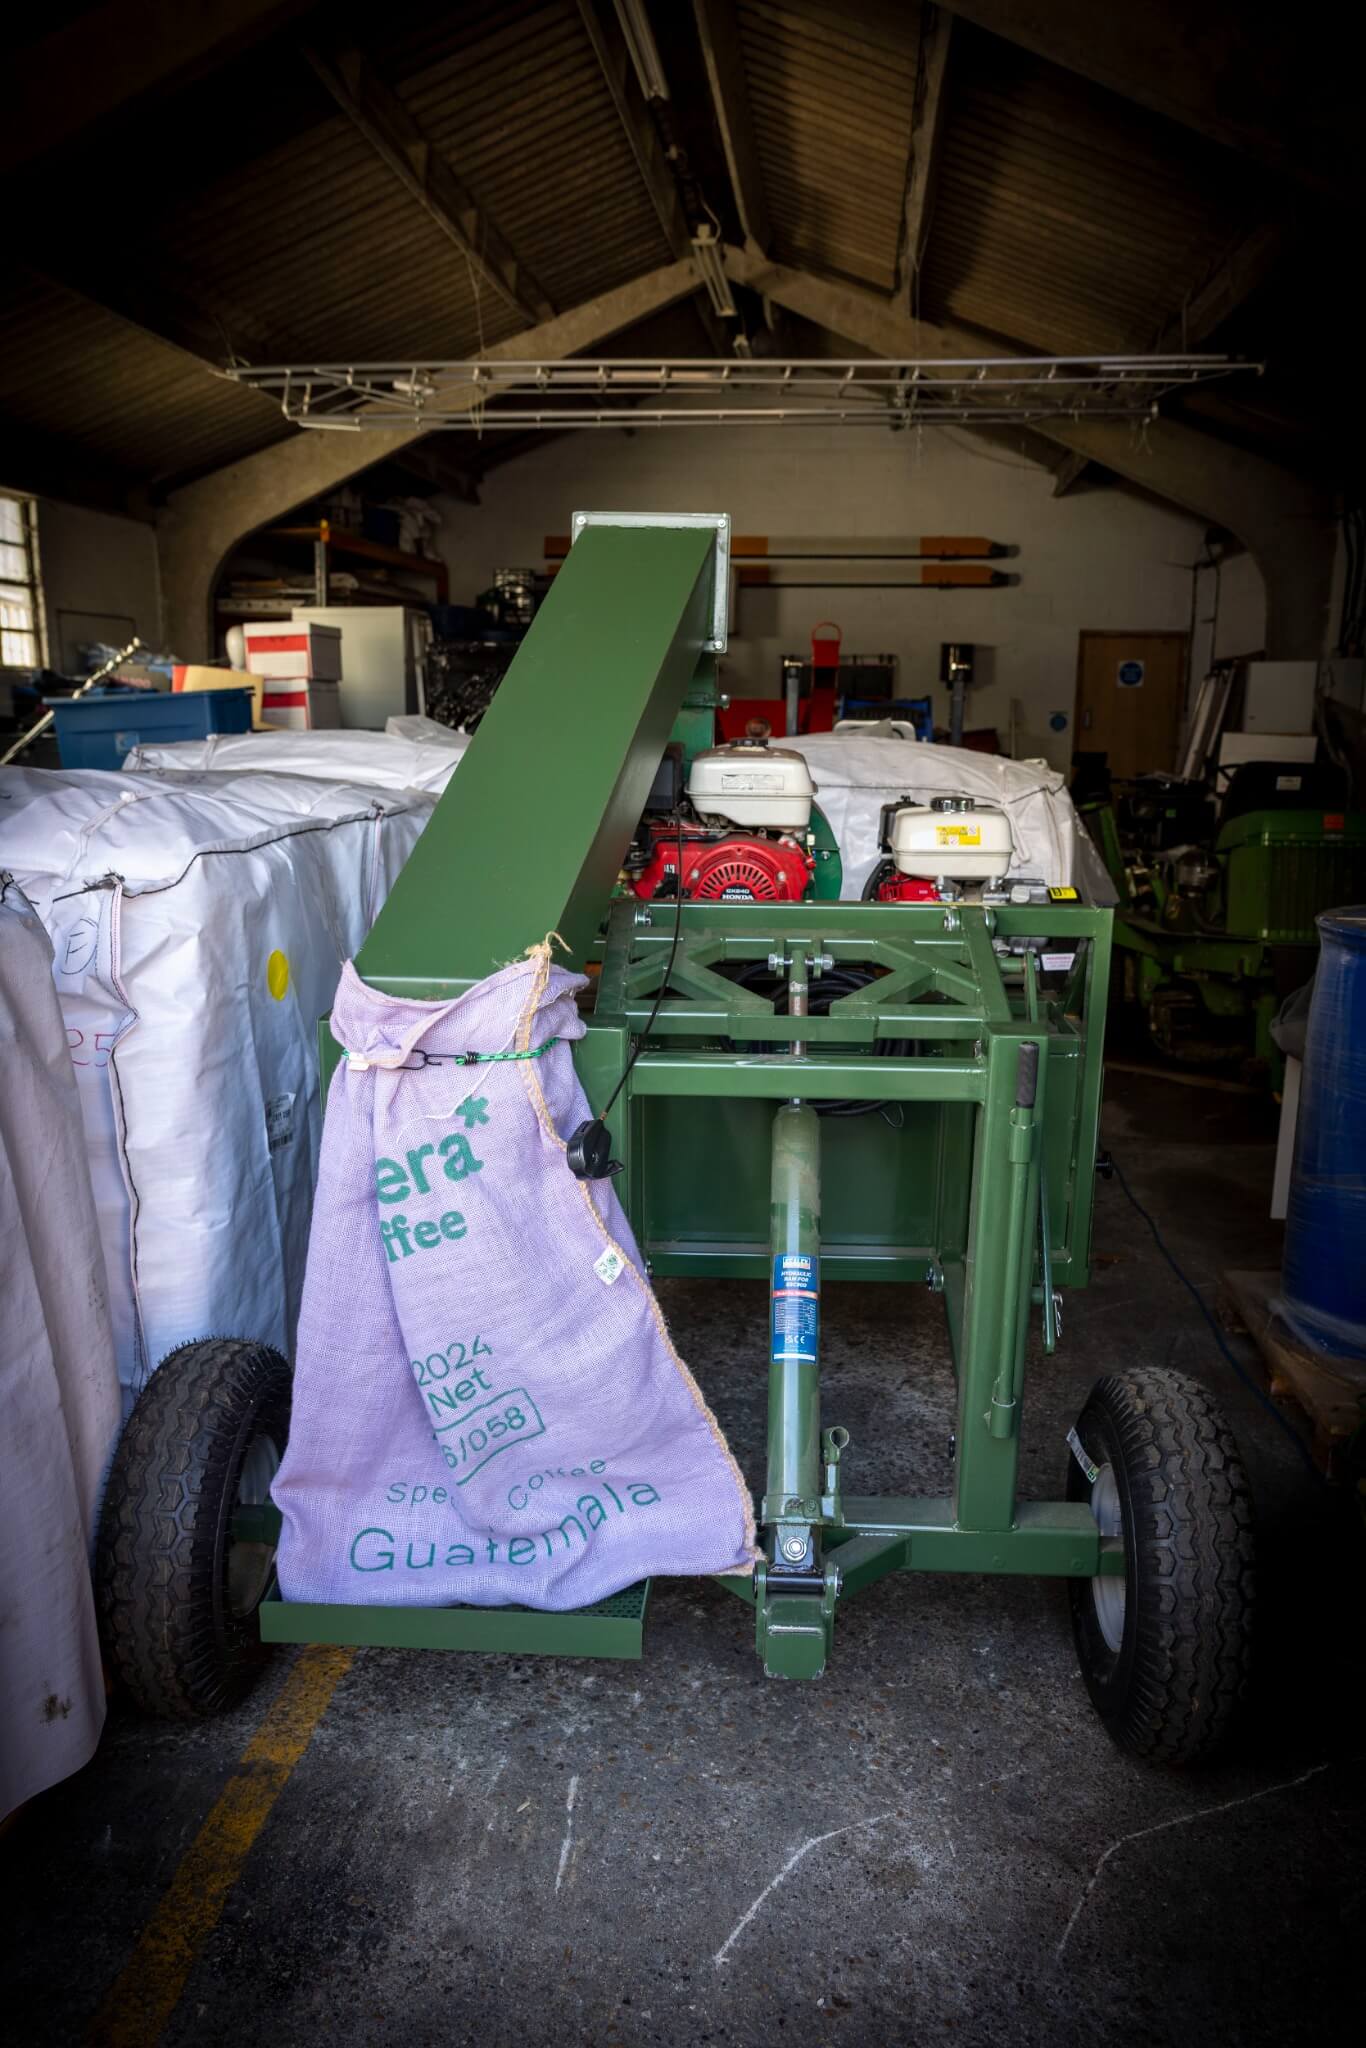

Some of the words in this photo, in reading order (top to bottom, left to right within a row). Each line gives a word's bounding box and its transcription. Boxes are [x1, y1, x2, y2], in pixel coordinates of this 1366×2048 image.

[411, 1335, 493, 1386] 2024
[427, 1368, 492, 1417] Net
[386, 1482, 453, 1508] Spe
[350, 1482, 661, 1572] Guatemala
